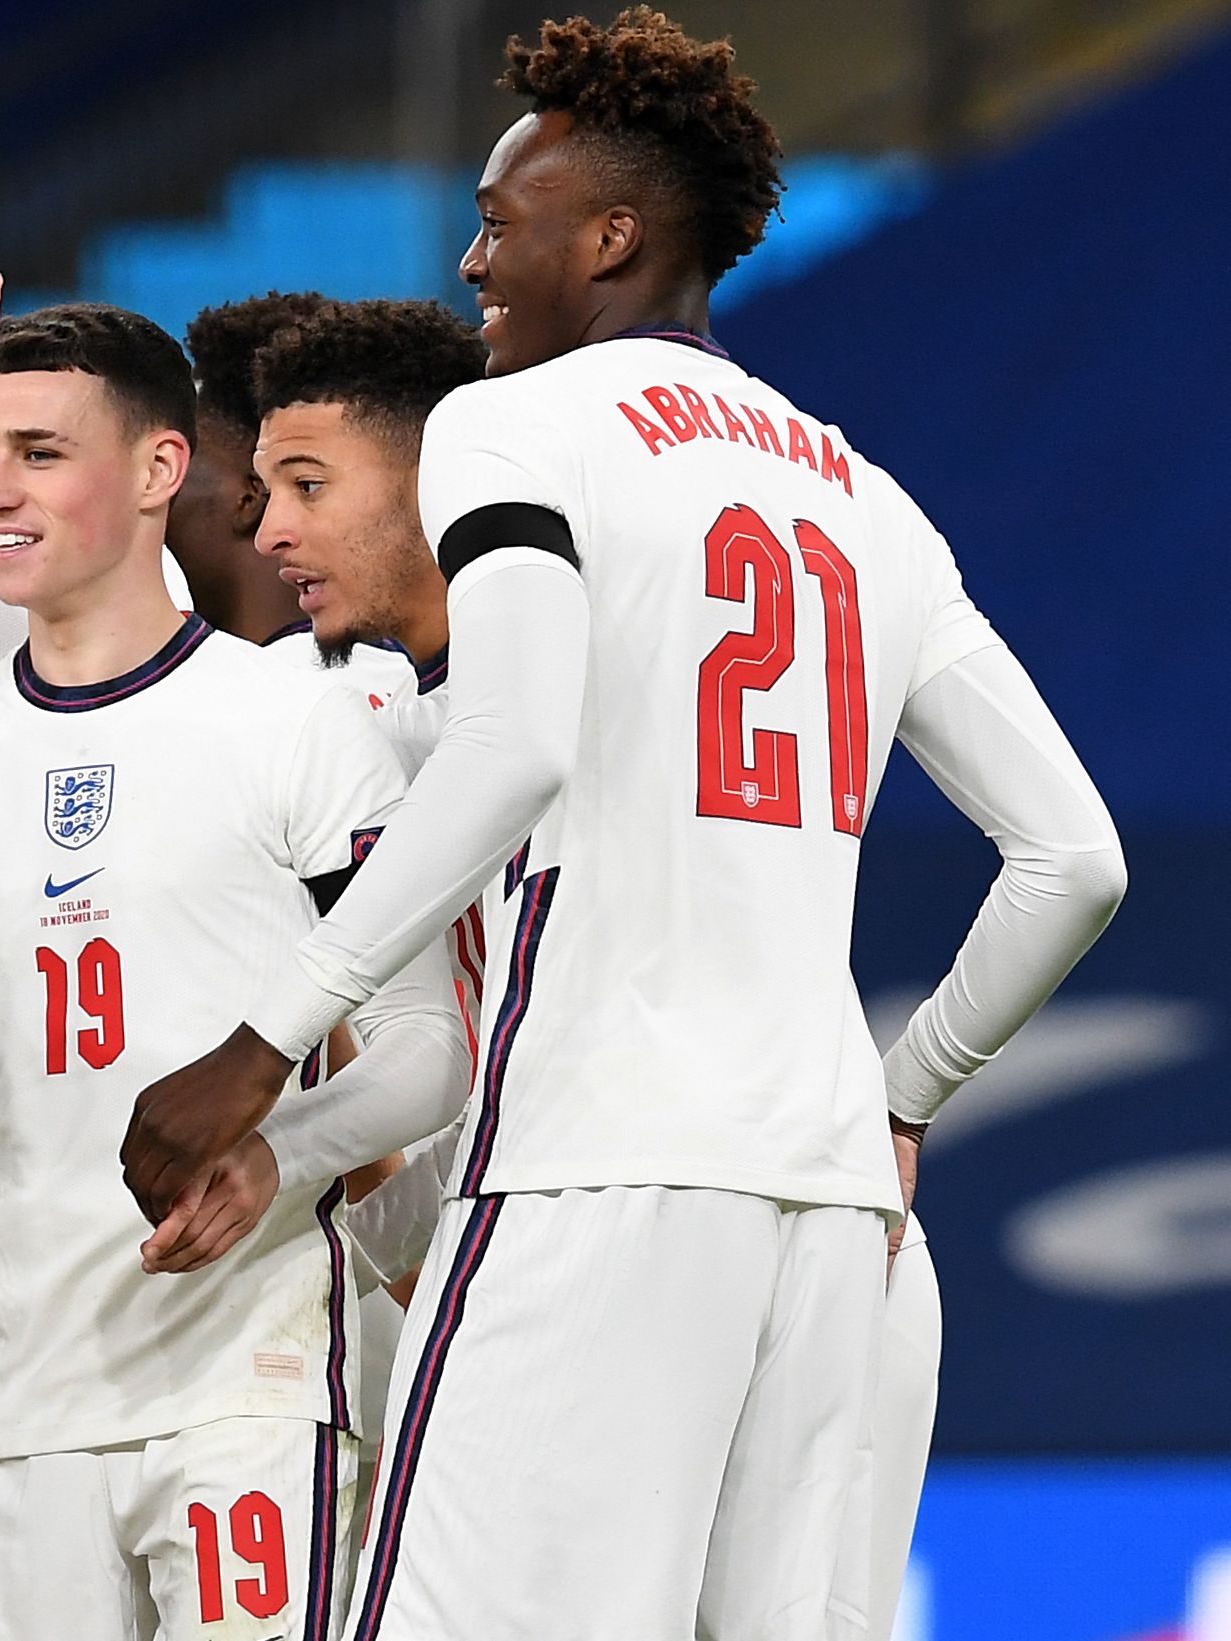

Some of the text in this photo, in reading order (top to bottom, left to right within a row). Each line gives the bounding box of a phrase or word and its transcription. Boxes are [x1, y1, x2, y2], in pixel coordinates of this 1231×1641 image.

[616, 383, 854, 498] ABRAHAM
[696, 503, 869, 838] 21
[50, 912, 91, 925] NOVEMBER
[59, 899, 91, 912] ICELAND
[35, 937, 125, 1075] 19
[187, 1490, 289, 1624] 19
